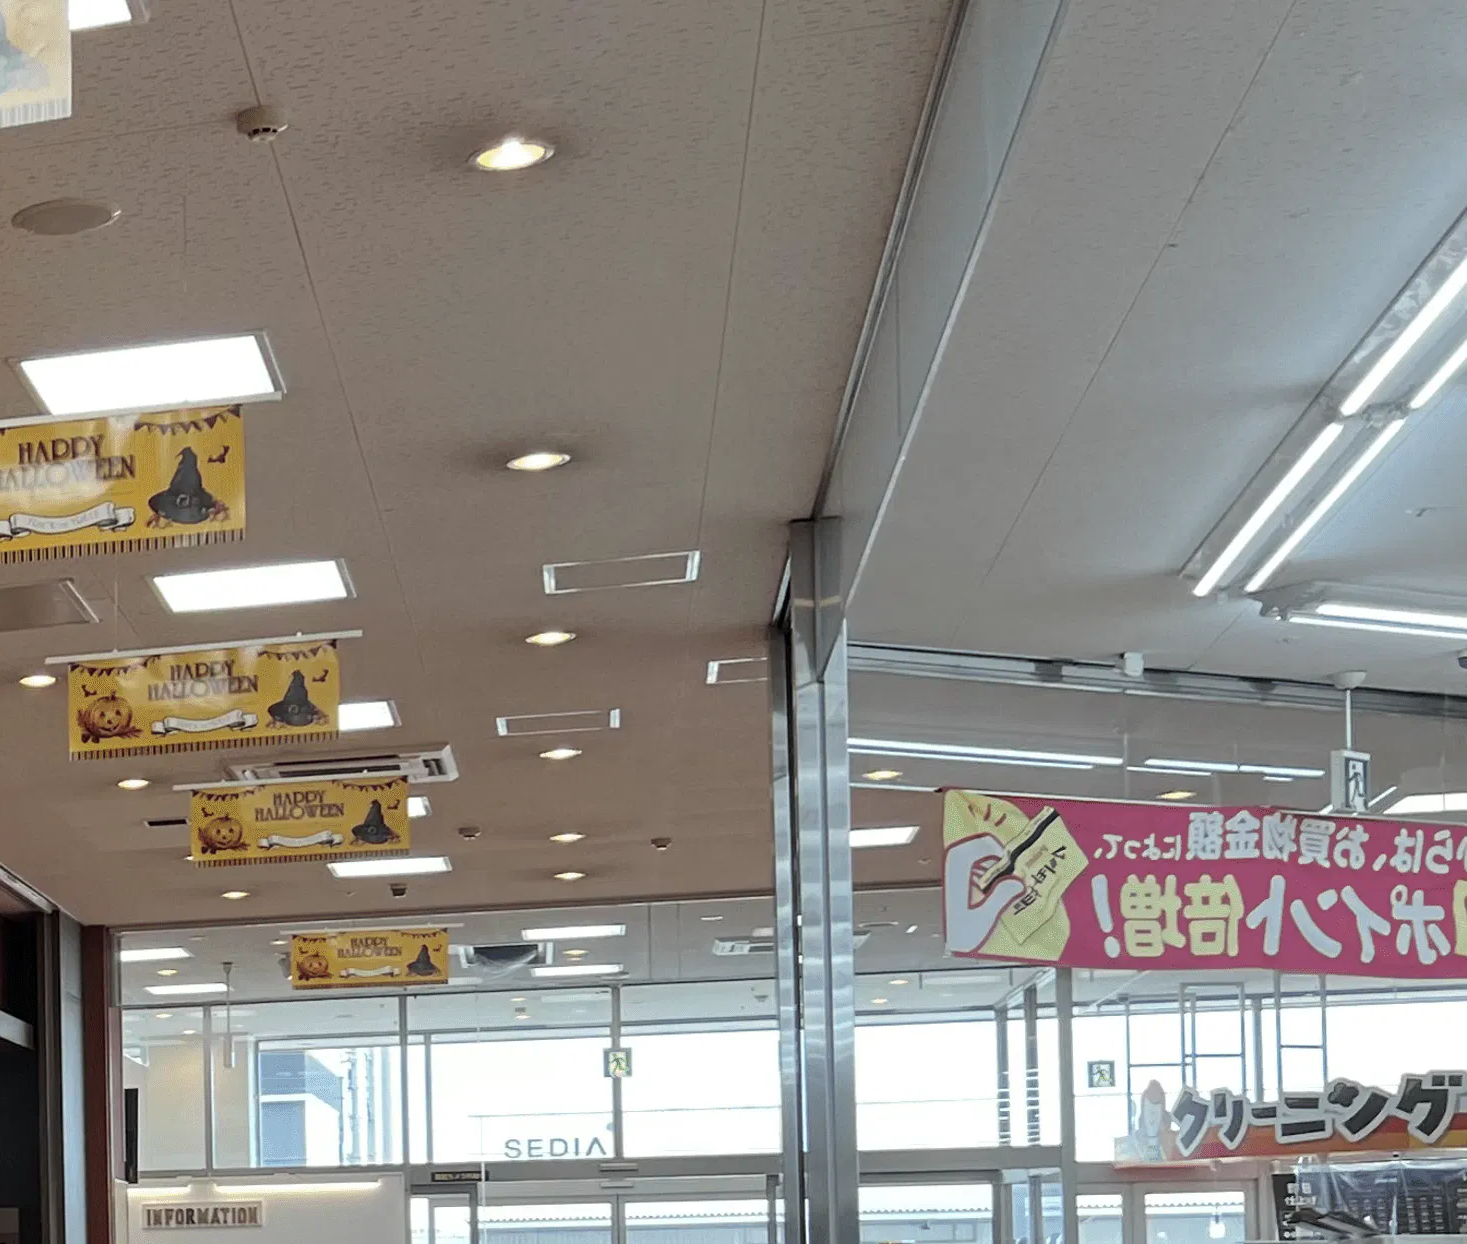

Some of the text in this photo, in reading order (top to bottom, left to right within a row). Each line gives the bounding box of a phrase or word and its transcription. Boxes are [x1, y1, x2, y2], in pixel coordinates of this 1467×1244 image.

[17, 433, 105, 466] HAPPY
[169, 658, 235, 684] HAPPY
[147, 673, 259, 702] HALLOWEEN
[272, 789, 326, 808] HAPPY
[254, 802, 345, 823] HALLOWEEN
[336, 944, 403, 959] HALLOWEEN
[350, 936, 389, 949] HAPPY
[1172, 1070, 1467, 1157] クリーニング
[146, 1203, 259, 1228] INFORMATION
